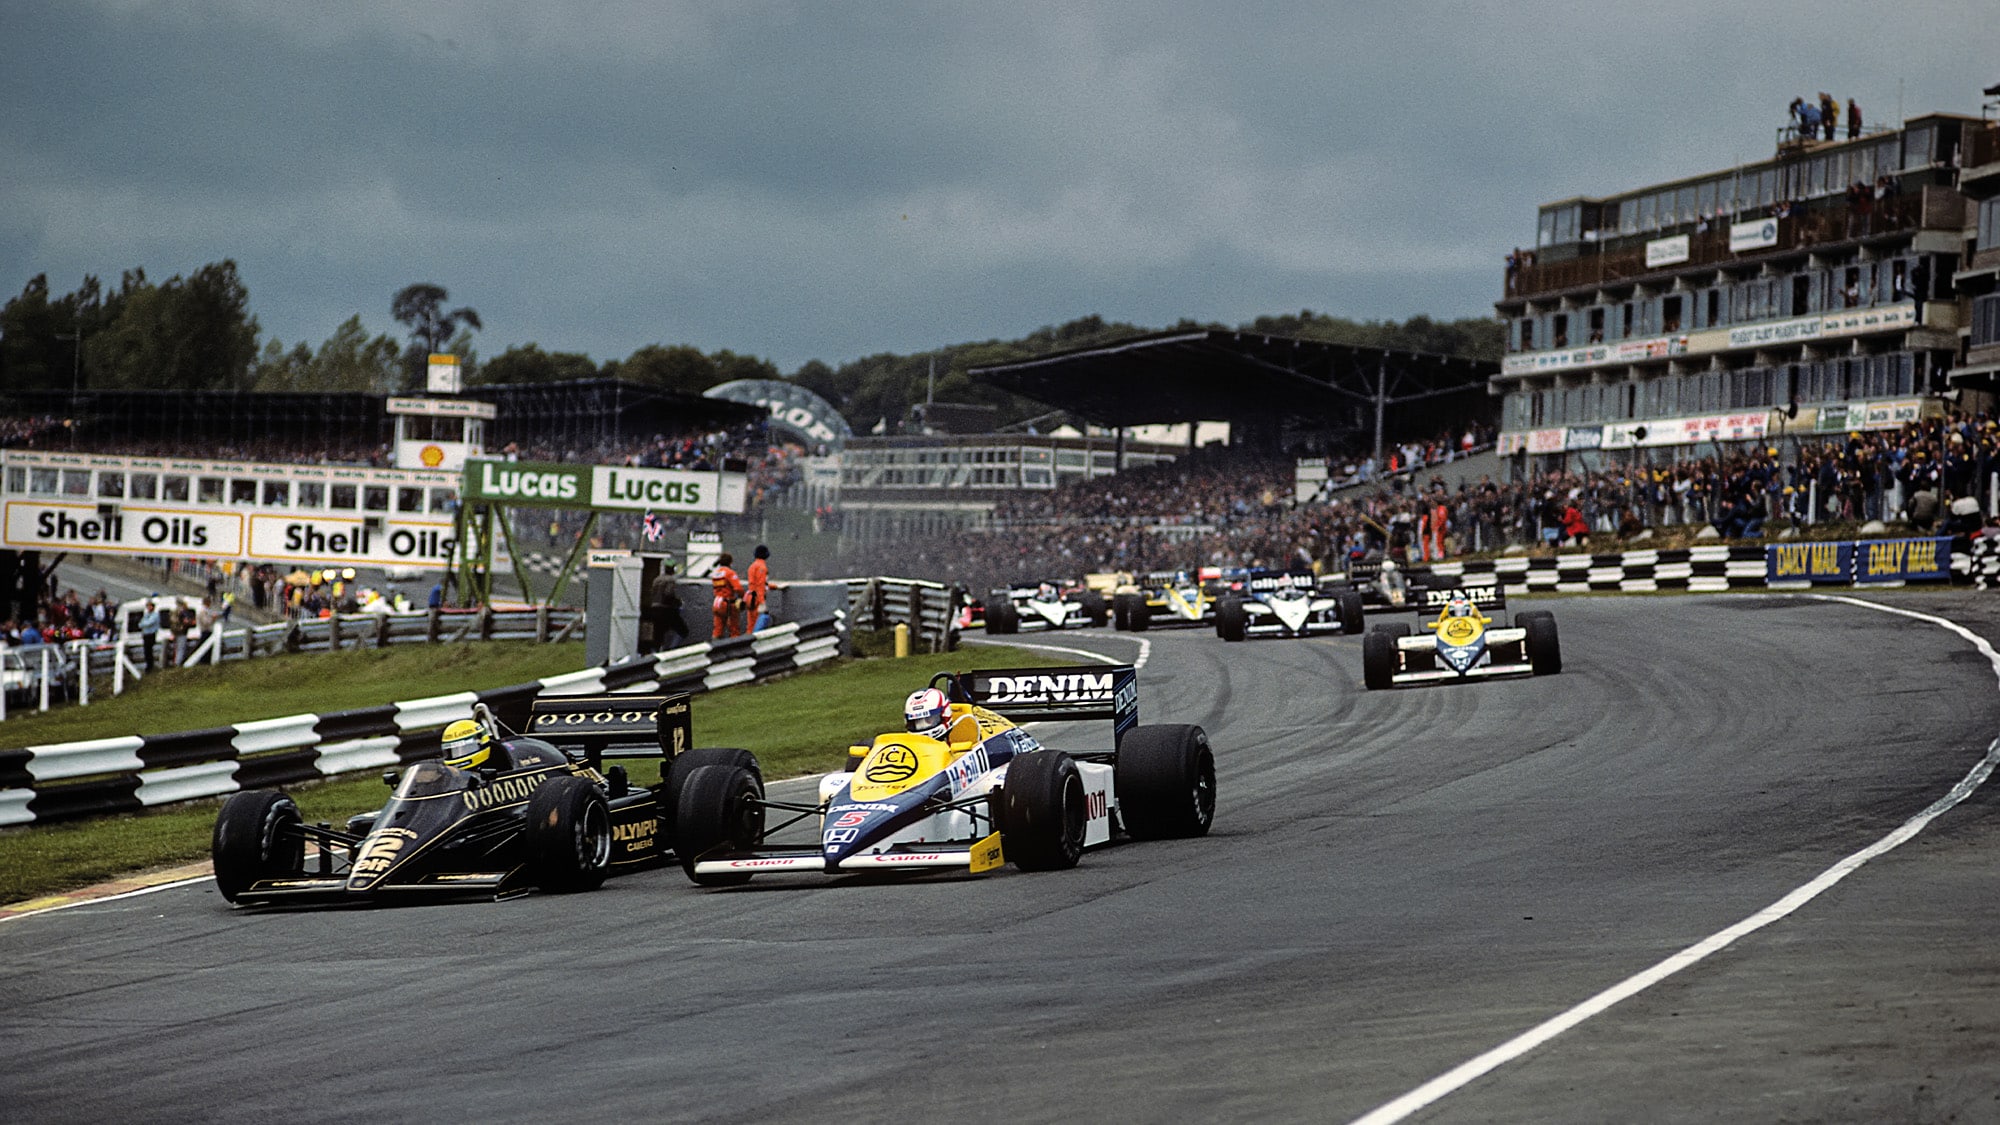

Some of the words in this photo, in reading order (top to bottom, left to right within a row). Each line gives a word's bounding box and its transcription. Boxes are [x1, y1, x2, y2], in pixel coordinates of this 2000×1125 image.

[757, 399, 834, 442] LOP
[481, 463, 577, 498] Lucas
[609, 471, 700, 504] Lucas
[37, 511, 122, 543] Shell
[142, 516, 208, 548] Oils
[285, 524, 370, 555] Shell
[390, 529, 457, 559] Oils
[689, 531, 721, 543] Lucas
[1776, 544, 1808, 576] DAILY
[1811, 543, 1841, 575] MAIL
[1868, 542, 1905, 576] DAILY
[1907, 541, 1938, 573] MAIL
[1251, 575, 1312, 590] olivtti
[986, 673, 1114, 703] DENIM
[673, 726, 685, 756] 12
[879, 750, 906, 764] ICI
[949, 753, 979, 795] Mobil
[827, 803, 899, 814] DENIM
[833, 811, 871, 827] 5
[612, 819, 657, 841] OLYMPU
[352, 858, 391, 872] elf
[730, 859, 795, 867] Canon
[874, 854, 939, 862] Canon
